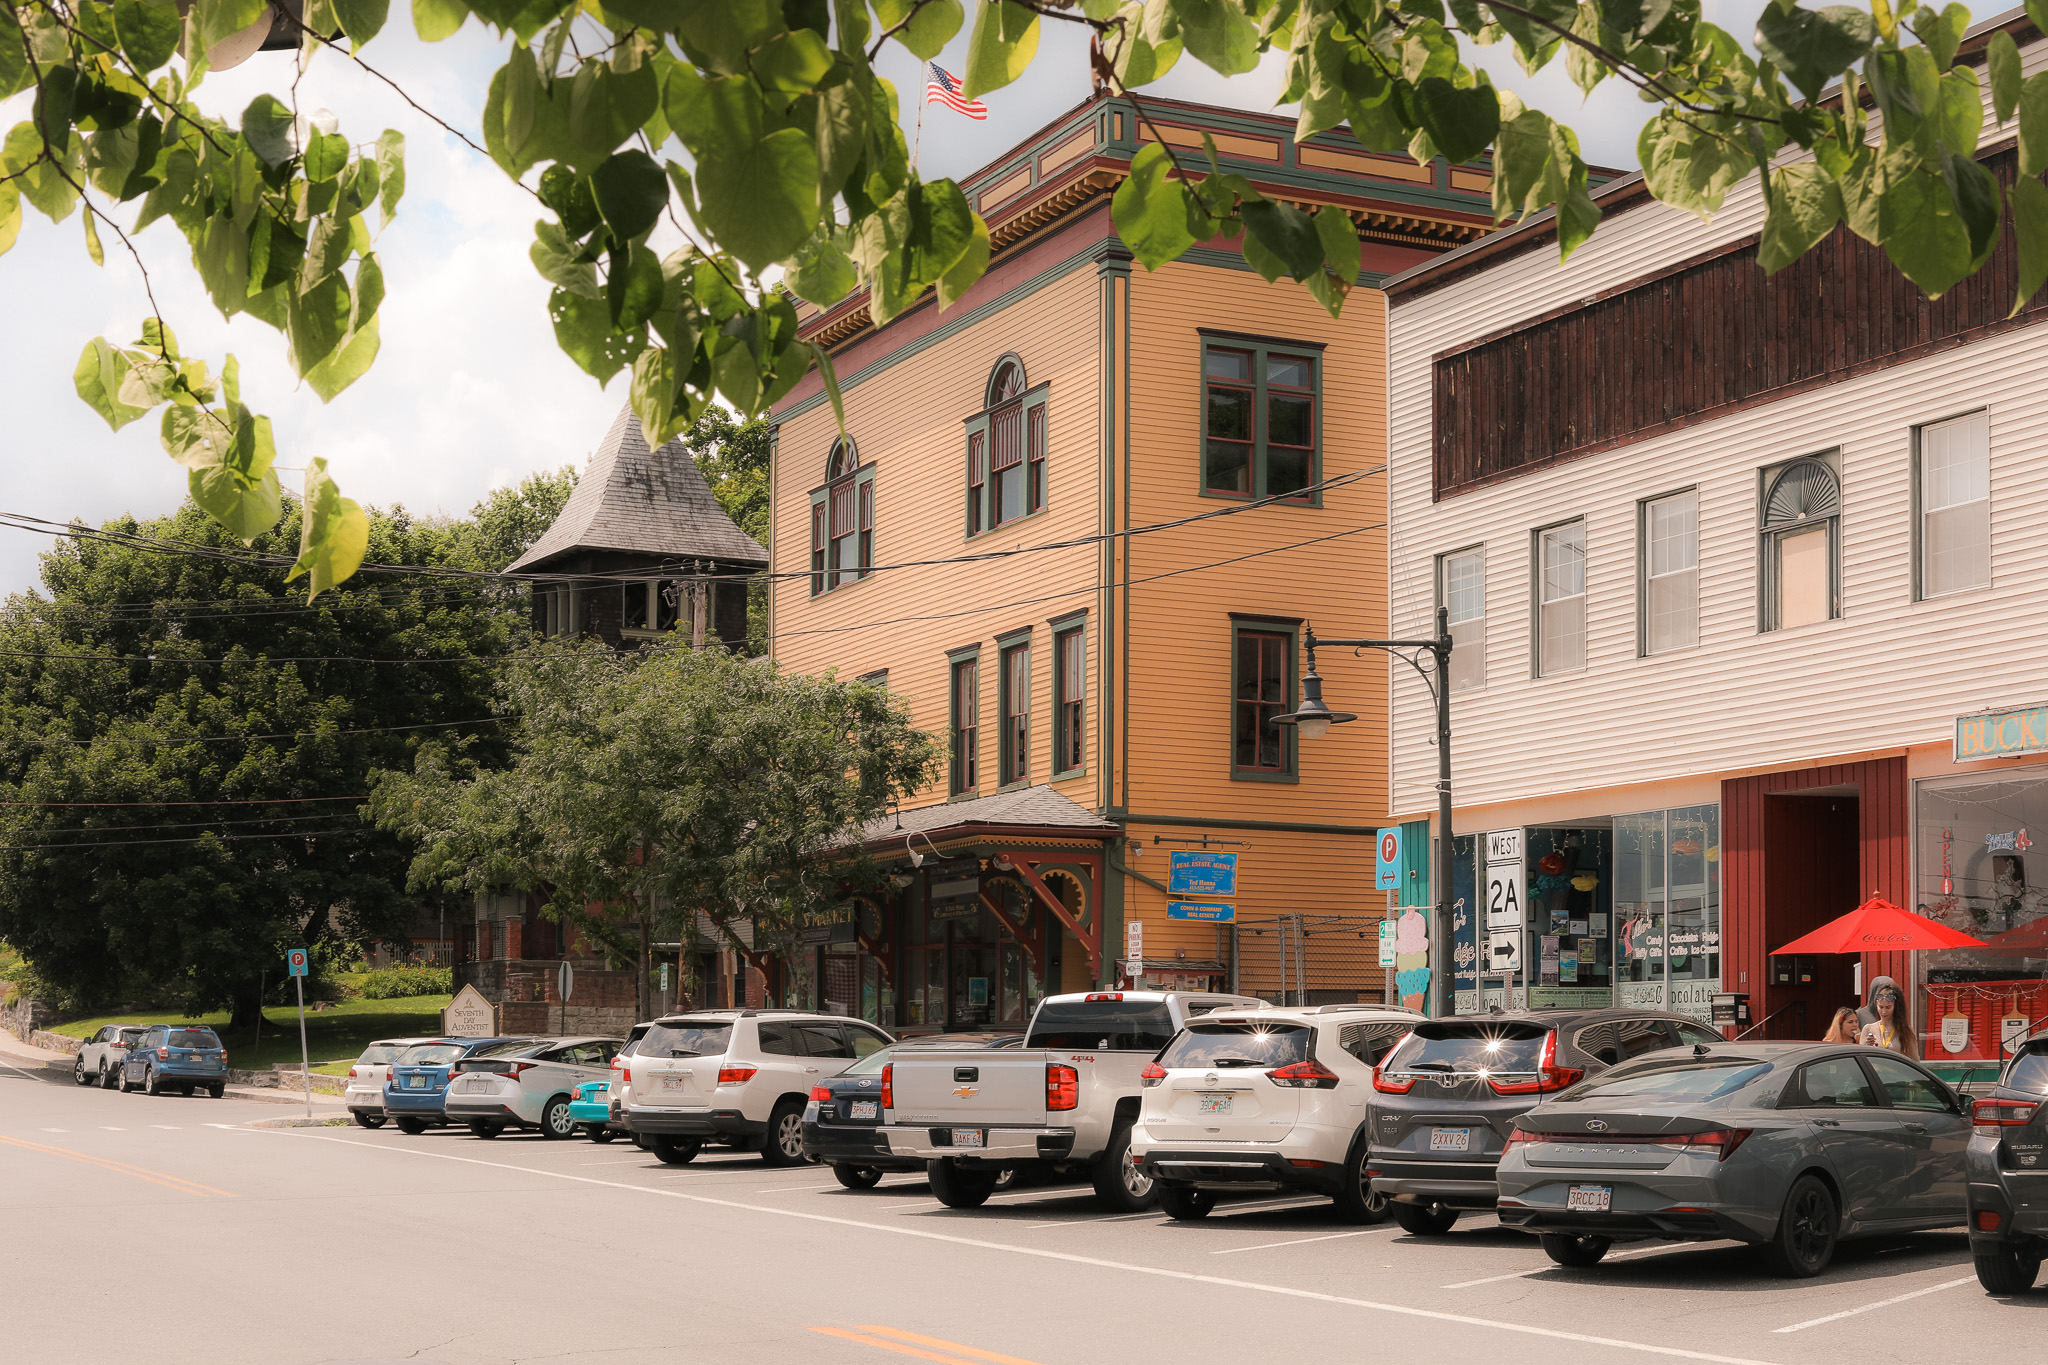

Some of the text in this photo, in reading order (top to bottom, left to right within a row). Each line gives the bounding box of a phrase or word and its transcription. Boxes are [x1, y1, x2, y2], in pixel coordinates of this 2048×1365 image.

[1961, 710, 2048, 755] BUCK
[1985, 831, 2016, 842] SAMUEL
[1386, 838, 1393, 858] P
[1492, 835, 1516, 855] WEST
[1986, 839, 2014, 852] ADAMS
[1942, 829, 1950, 878] OPEN
[1490, 878, 1518, 914] 2A
[1132, 924, 1138, 932] NO
[1380, 925, 1385, 936] 2
[1646, 931, 1719, 947] Candy Chocolates Fudge
[1669, 945, 1688, 956] Coffee
[1691, 945, 1700, 954] Ice
[1700, 944, 1719, 955] Cream
[295, 954, 301, 964] P
[455, 1009, 484, 1017] SEVENTH
[452, 1023, 489, 1031] ADVENTIST
[972, 1133, 981, 1144] 64
[1433, 1133, 1467, 1145] 2XXV 26
[1554, 1147, 1638, 1155] ELANTRA
[1570, 1192, 1609, 1206] 3RCC 18
